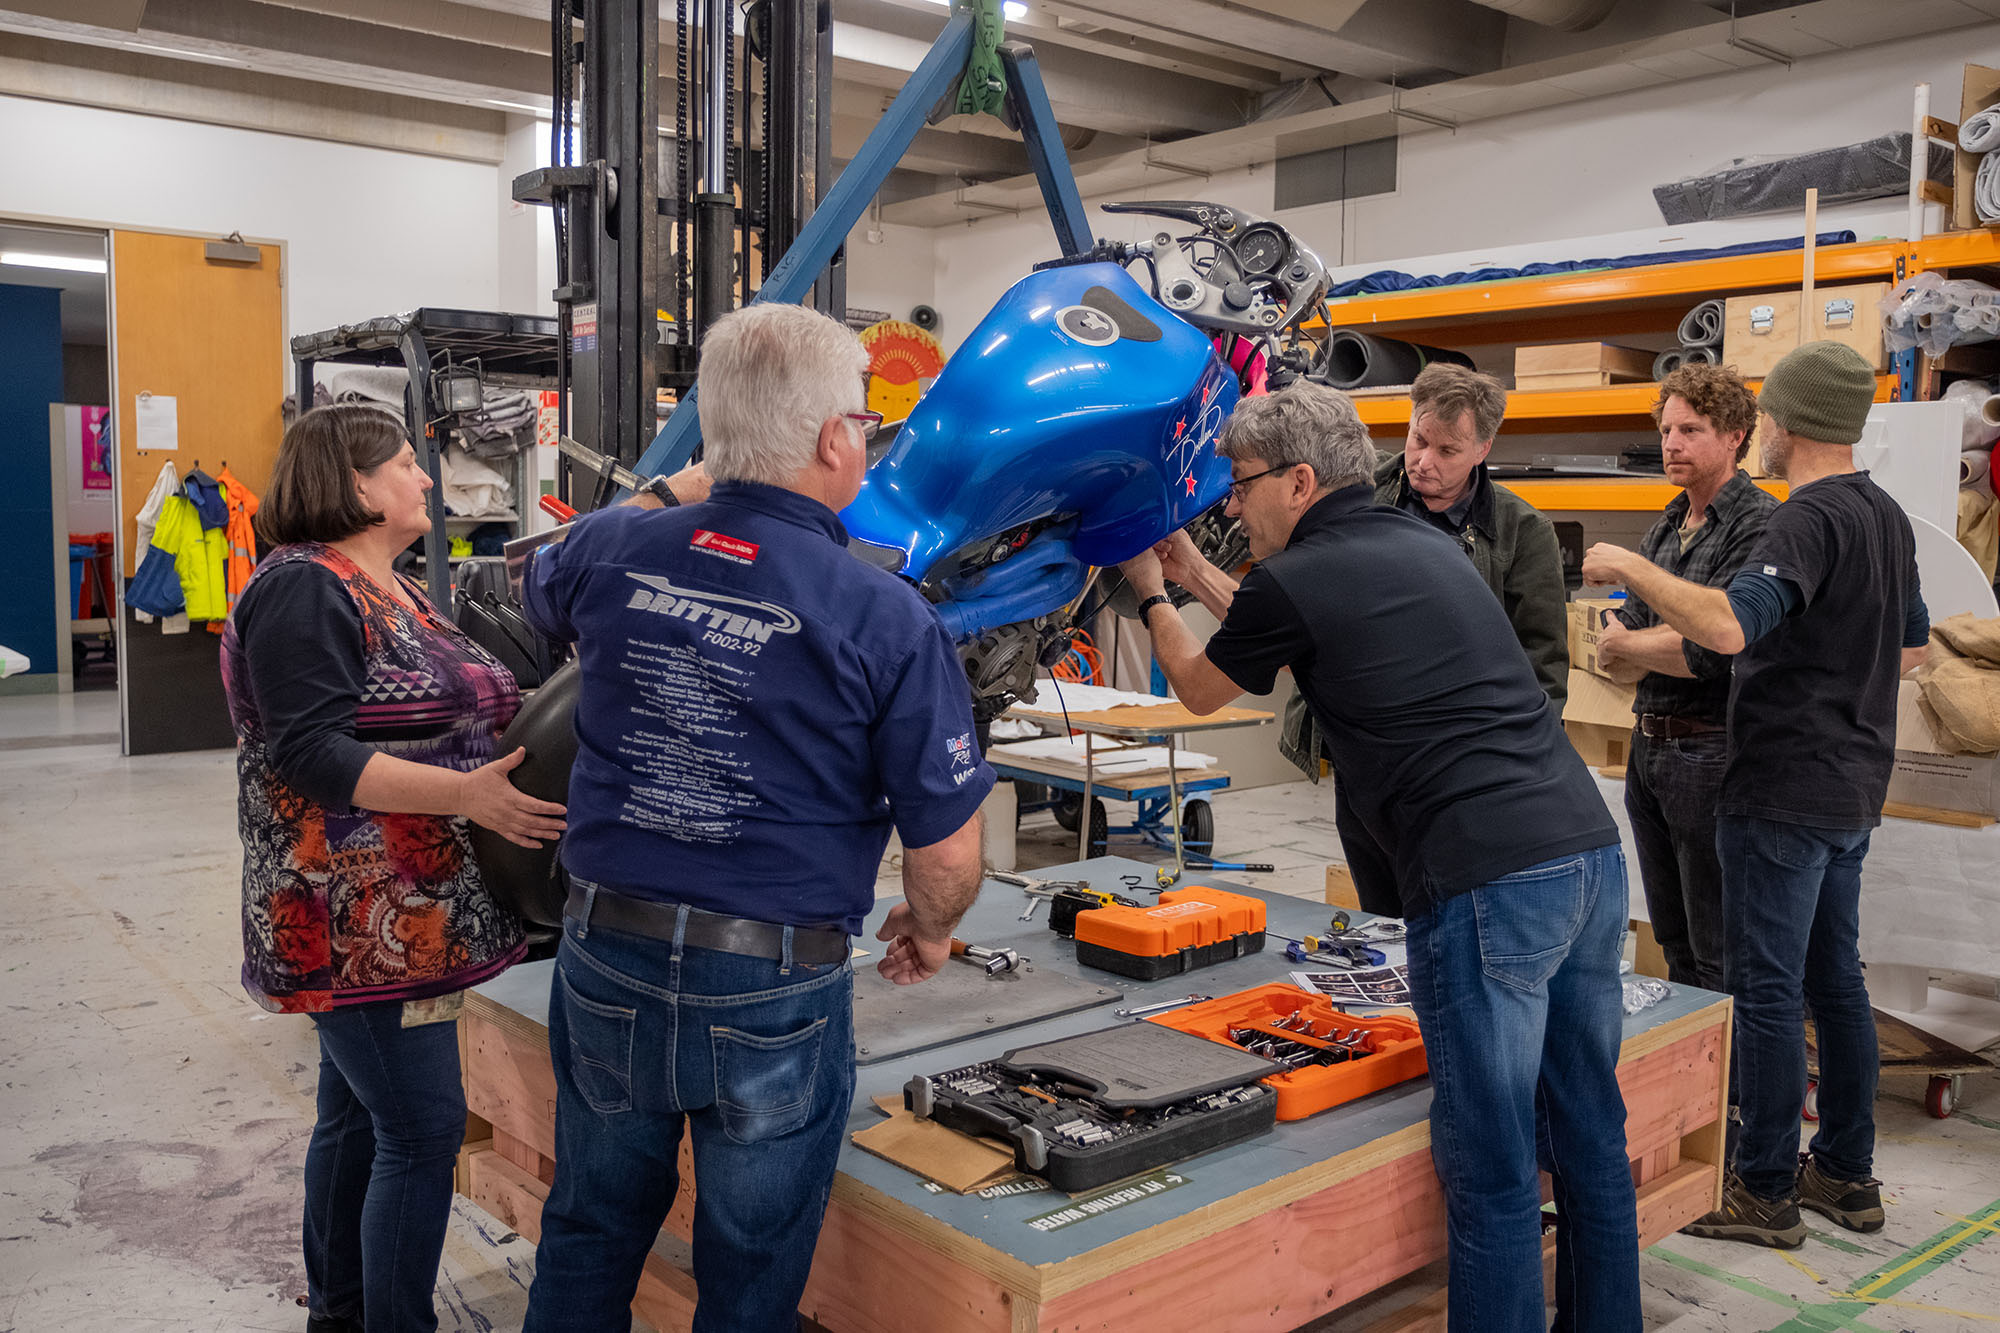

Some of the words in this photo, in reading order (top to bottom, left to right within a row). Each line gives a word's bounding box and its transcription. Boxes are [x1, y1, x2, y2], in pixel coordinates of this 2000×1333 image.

[626, 589, 774, 644] BRITTEN
[702, 630, 762, 657] F002-92
[1140, 1180, 1166, 1193] HT
[1078, 1187, 1146, 1214] HEATING
[1028, 1208, 1087, 1232] WATER
